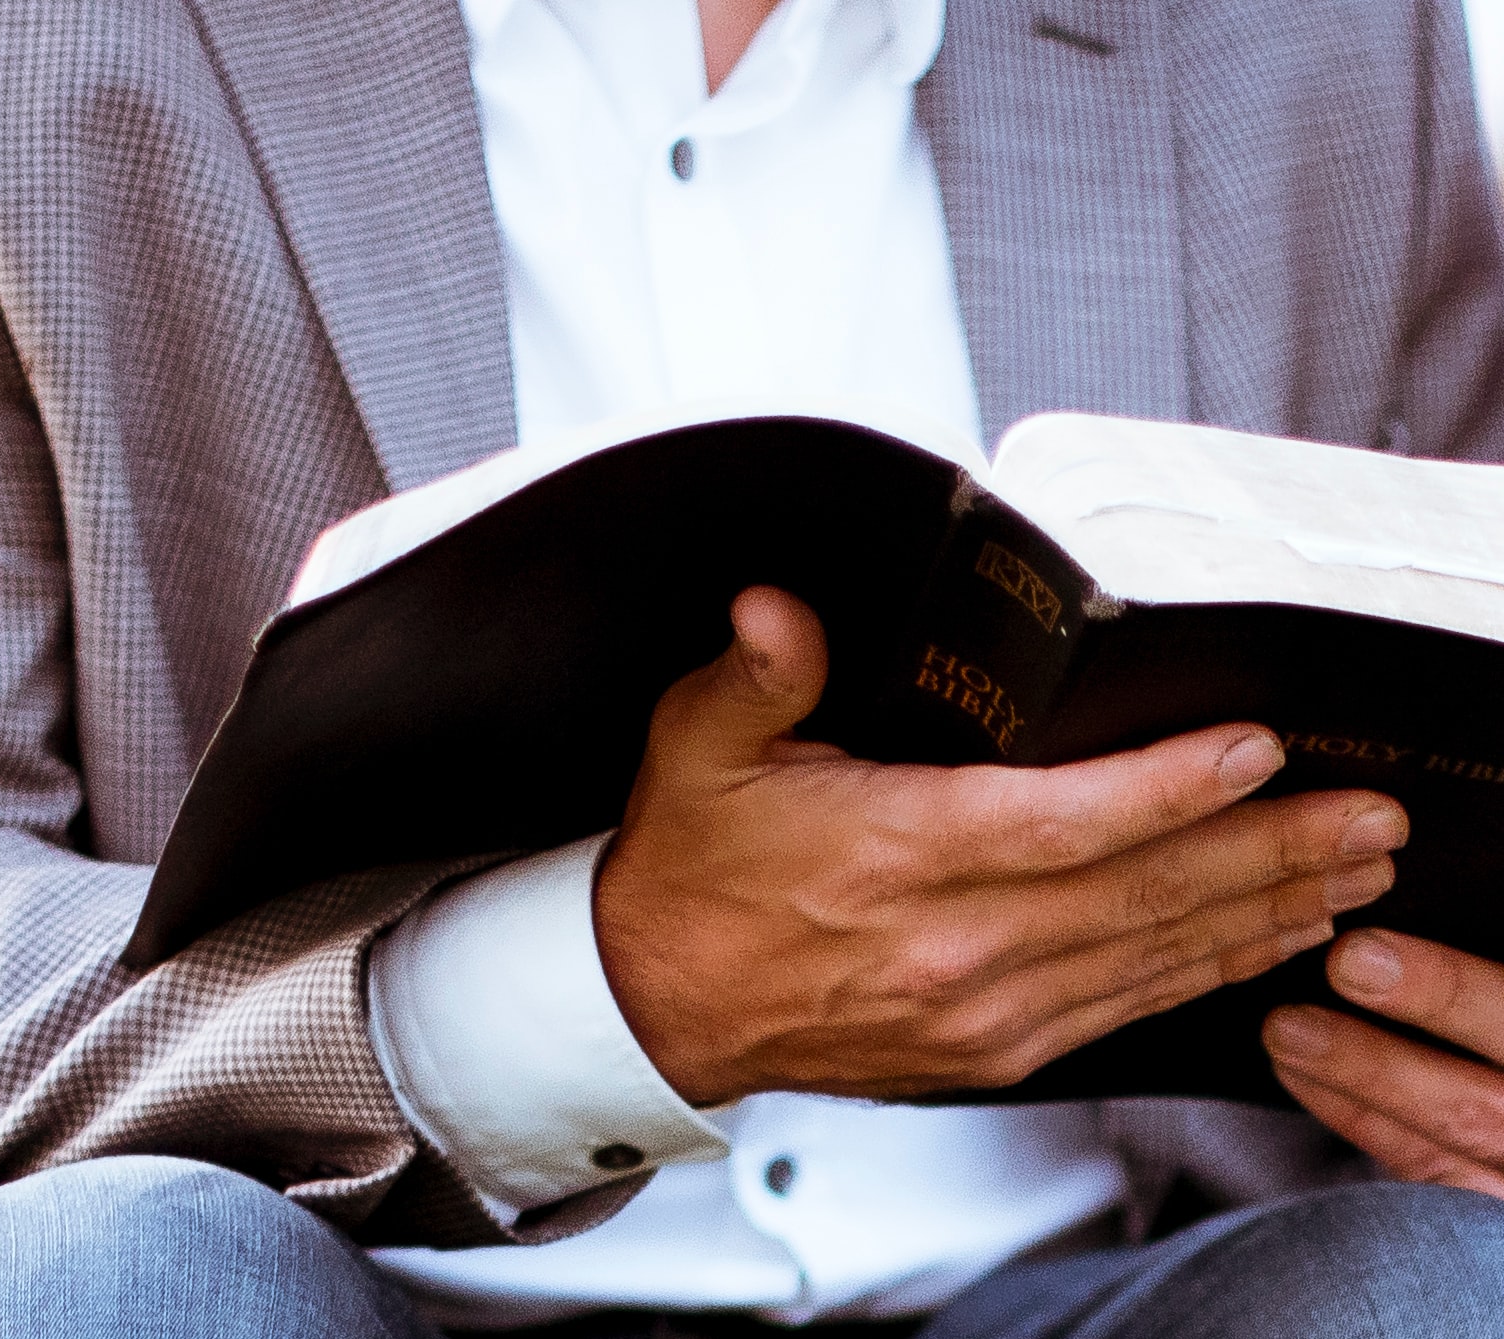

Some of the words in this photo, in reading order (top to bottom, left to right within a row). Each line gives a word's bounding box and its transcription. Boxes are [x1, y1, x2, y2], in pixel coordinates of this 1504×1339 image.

[915, 668, 1014, 757] BIBLE
[924, 643, 1025, 732] HOLY
[1284, 732, 1415, 763] HOLY
